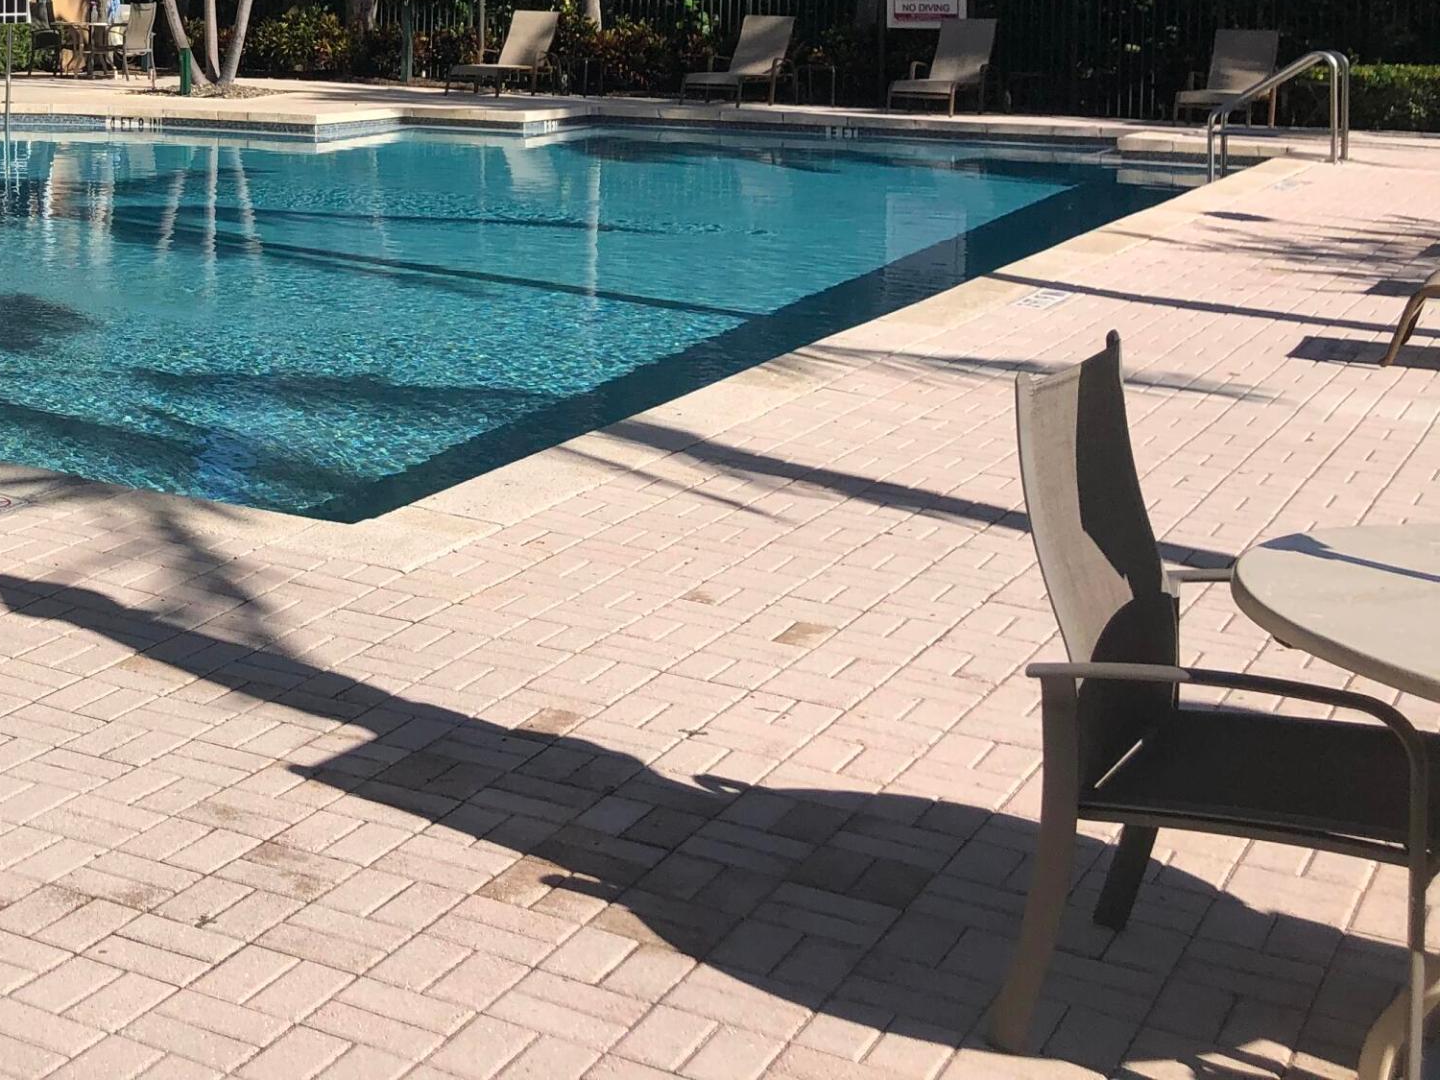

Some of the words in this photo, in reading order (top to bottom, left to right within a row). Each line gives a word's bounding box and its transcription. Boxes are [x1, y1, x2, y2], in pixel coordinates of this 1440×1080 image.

[902, 4, 916, 12] NO
[918, 4, 951, 12] DIVING
[121, 117, 134, 128] FT
